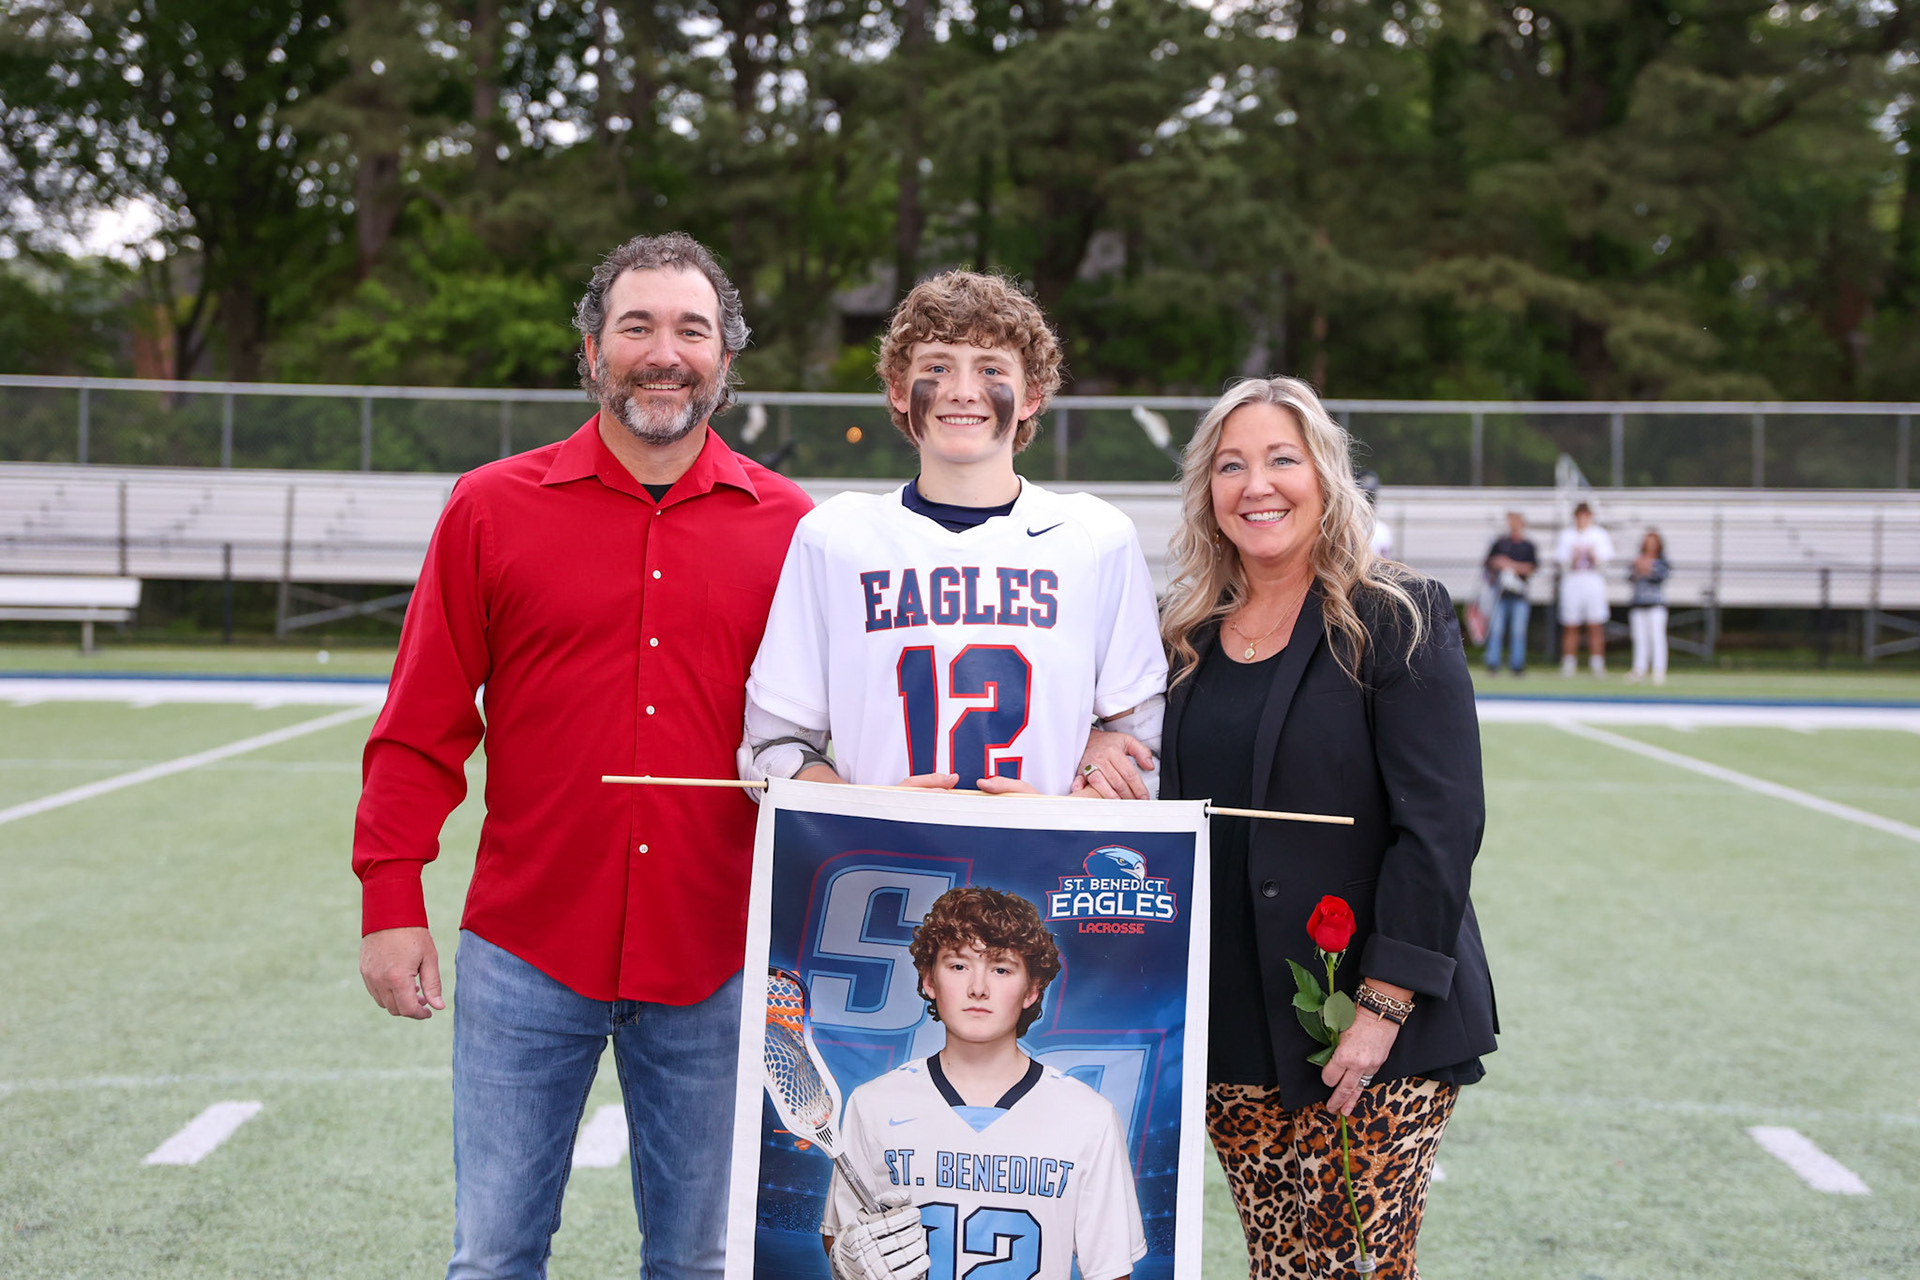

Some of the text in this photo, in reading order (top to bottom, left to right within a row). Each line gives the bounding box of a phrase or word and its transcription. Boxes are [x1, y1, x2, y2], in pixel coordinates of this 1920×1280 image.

[860, 566, 1059, 633] EAGLES
[896, 644, 1032, 790] 12
[1064, 878, 1165, 893] ST. BENEDICT
[1051, 892, 1174, 919] EAGLES
[1078, 922, 1146, 934] LACROSSE
[884, 1149, 1075, 1199] ST. BENEDICT
